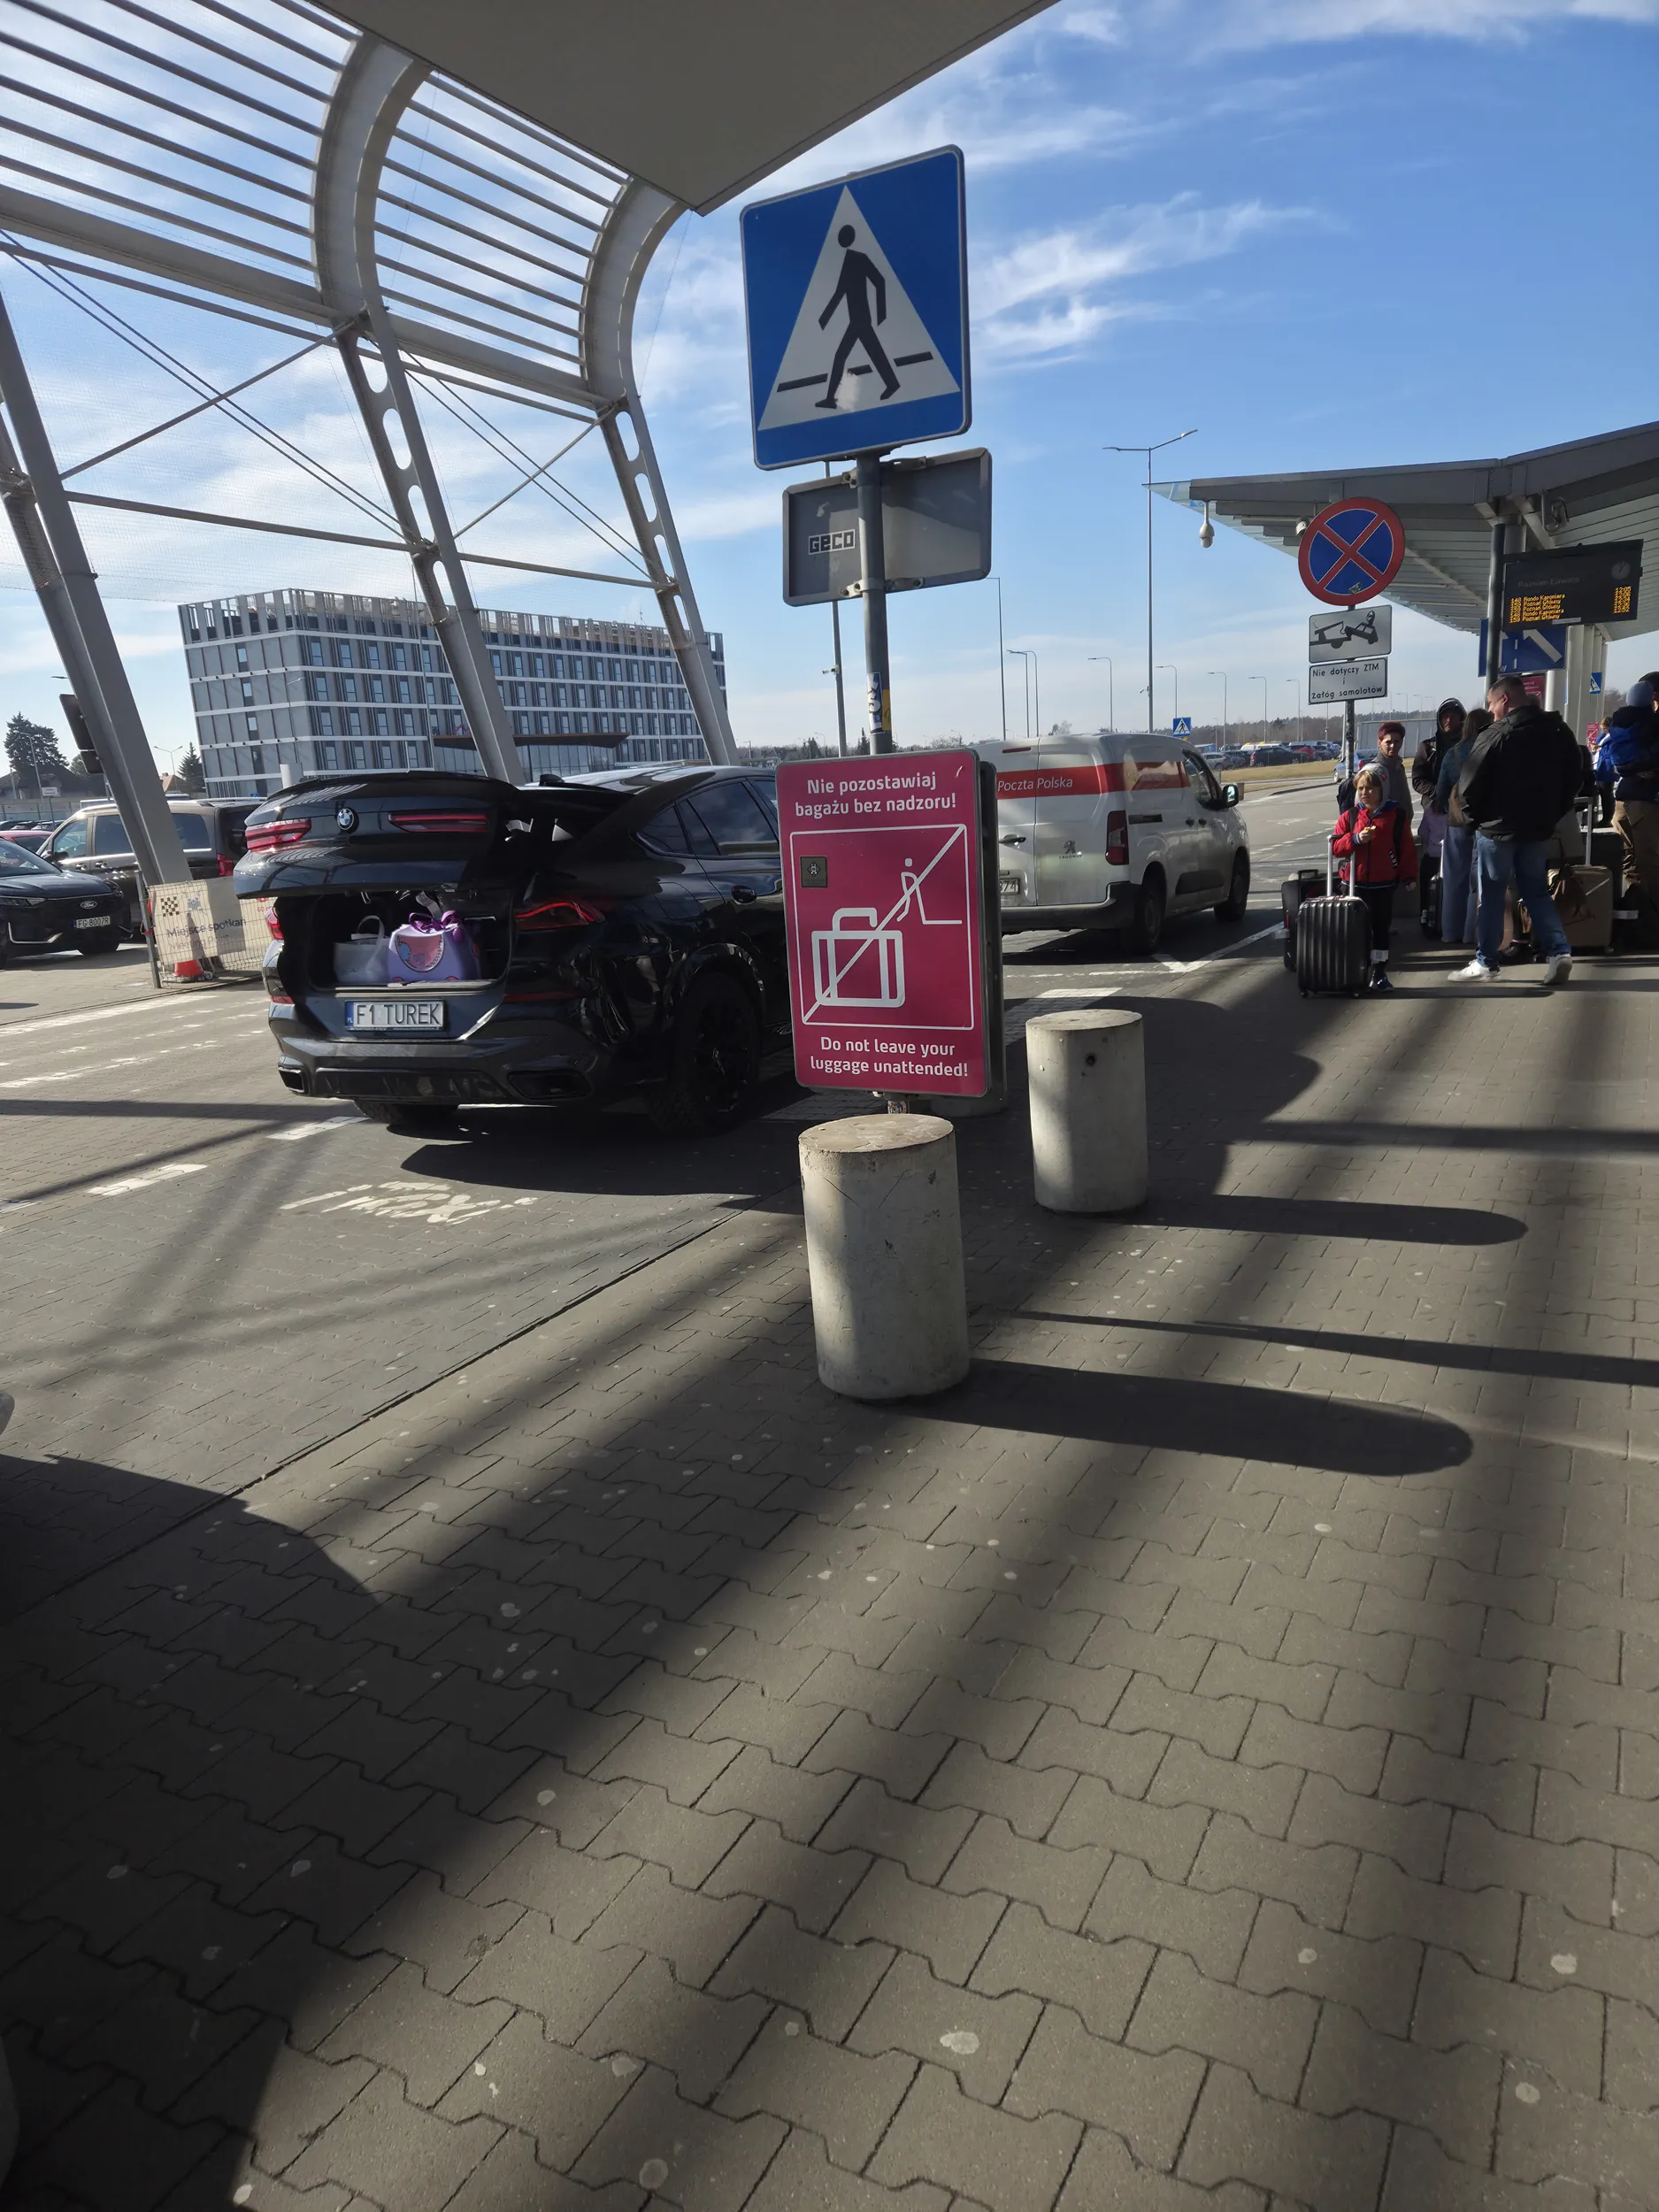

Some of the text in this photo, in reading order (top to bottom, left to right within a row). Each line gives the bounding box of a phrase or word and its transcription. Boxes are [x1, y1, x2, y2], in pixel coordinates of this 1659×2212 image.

[1363, 663, 1379, 672] ZTM
[1339, 686, 1382, 696] samolotów
[807, 772, 936, 795] Nie pozostawiaj
[997, 776, 1073, 792] Poczta Polska
[795, 793, 956, 818] bagażu bez nadzoru!
[89, 918, 109, 926] 8007R
[167, 918, 246, 938] Miejsce spotkań
[357, 1003, 440, 1025] F1 TUREK
[821, 1037, 955, 1057] Do not leave your
[810, 1056, 968, 1076] luggage unattended!
